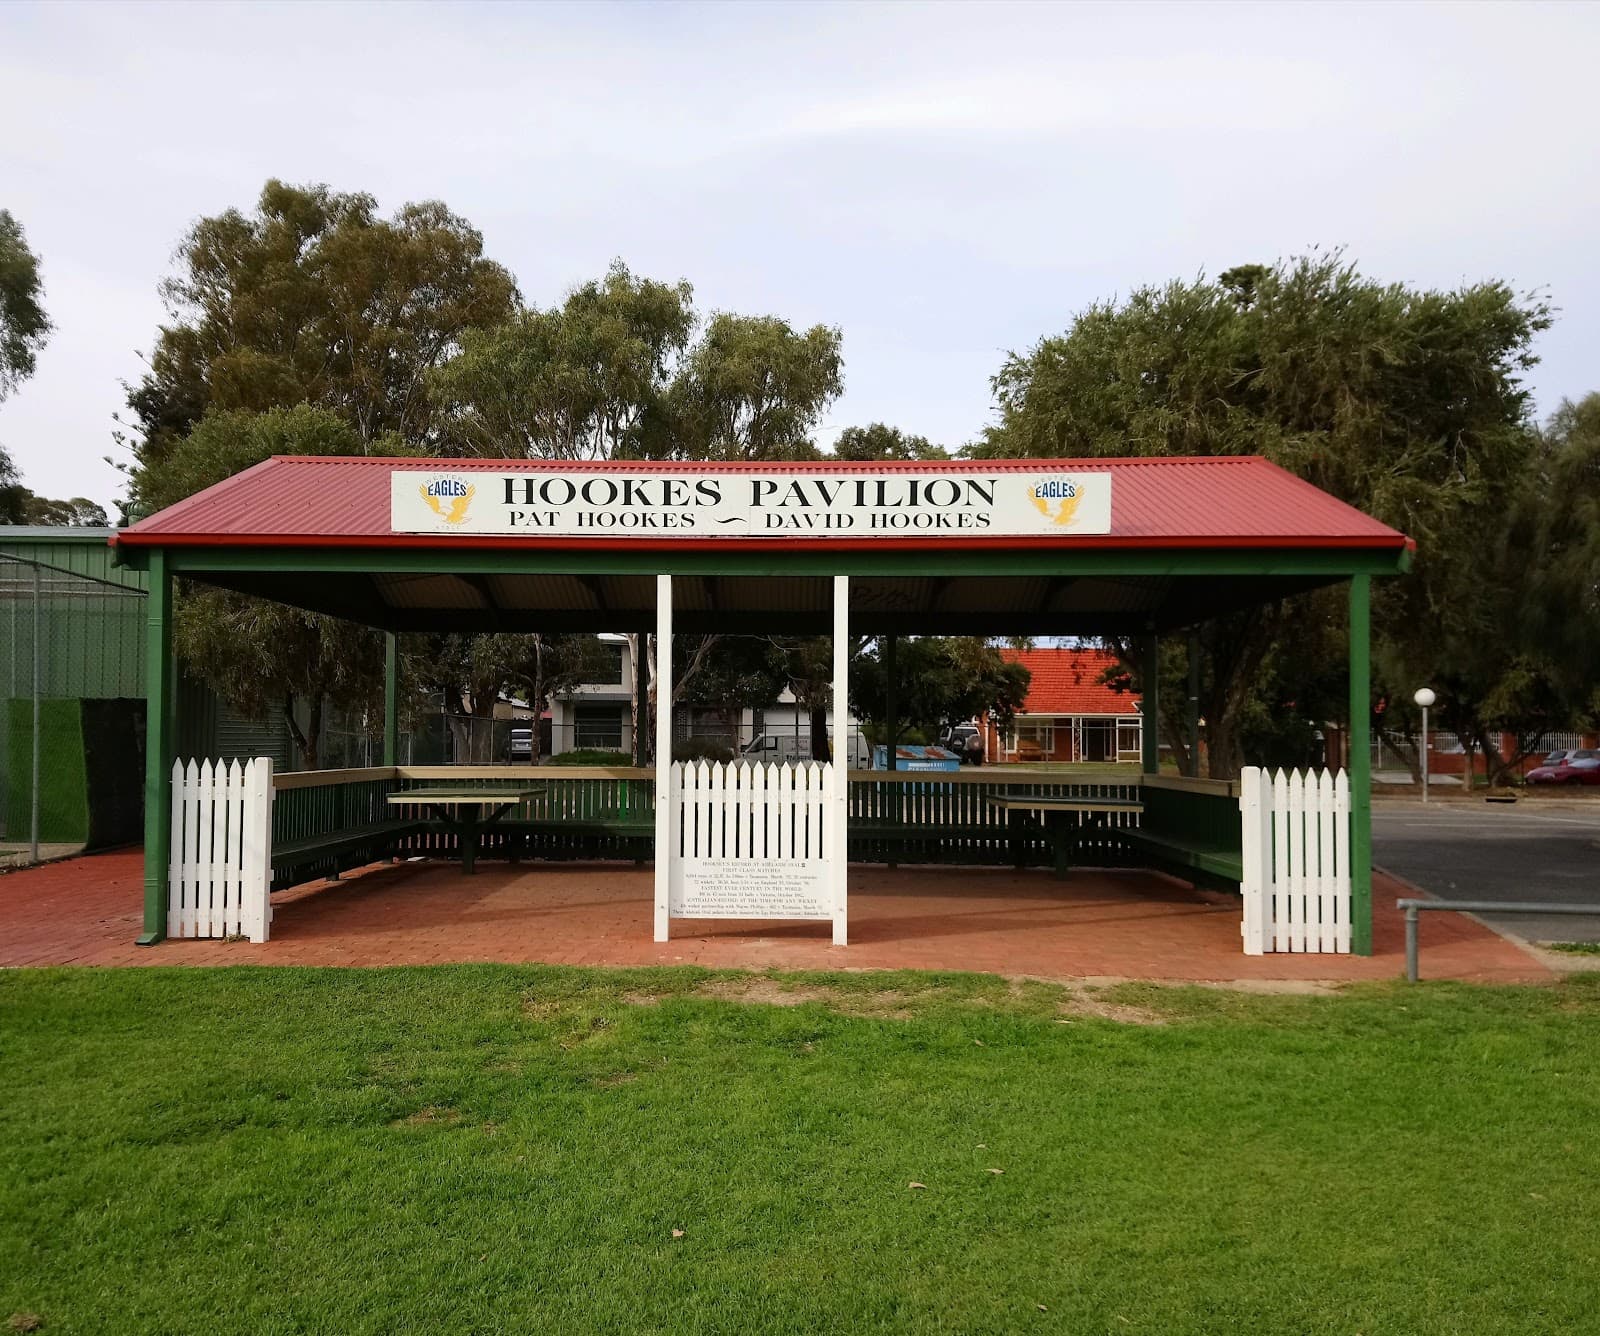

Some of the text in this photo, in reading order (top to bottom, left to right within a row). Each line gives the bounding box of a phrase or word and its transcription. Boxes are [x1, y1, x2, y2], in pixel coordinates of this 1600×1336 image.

[428, 480, 466, 496] EAGLES
[503, 478, 997, 506] HOOKES PAVILION
[1035, 481, 1075, 497] EAGLES
[511, 512, 694, 527] PAT HOOKES
[767, 514, 990, 528] DAVID HOOKES
